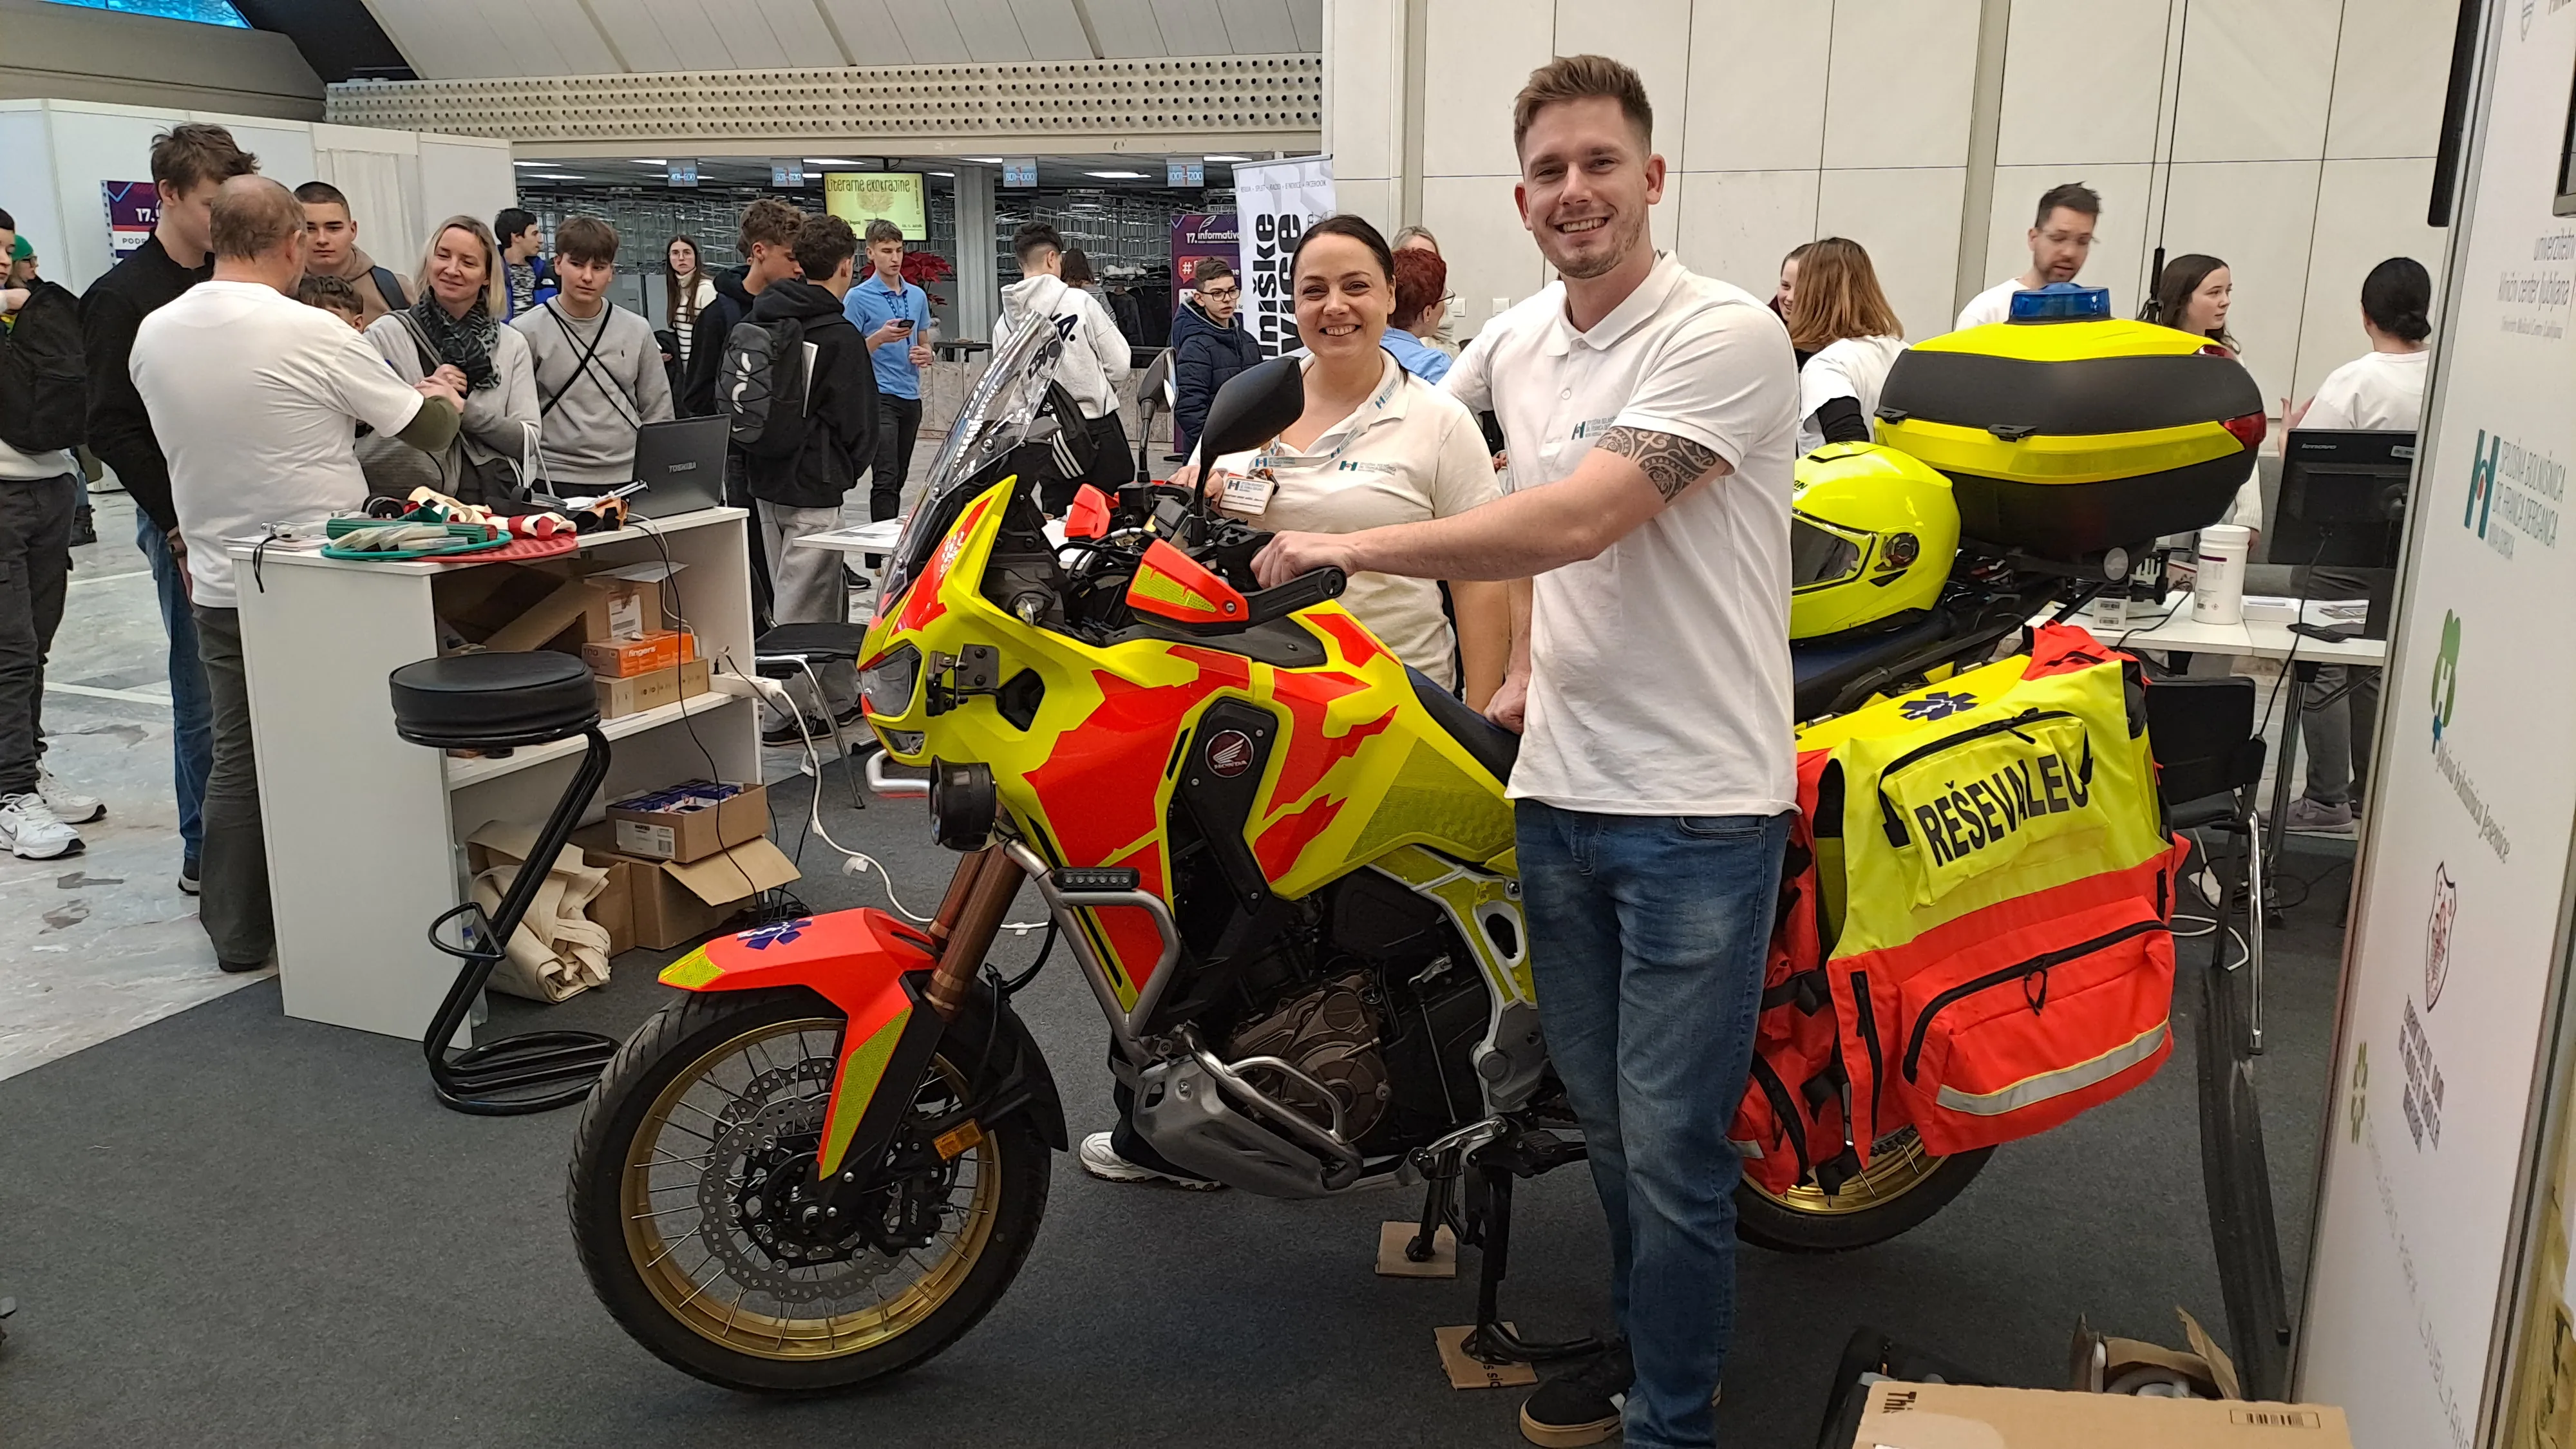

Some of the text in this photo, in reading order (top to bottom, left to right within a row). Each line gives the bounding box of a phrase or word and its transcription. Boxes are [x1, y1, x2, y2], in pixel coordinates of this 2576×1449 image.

[135, 208, 155, 222] 17.
[1186, 232, 1197, 244] 17.
[668, 461, 697, 473] TOSHIBA
[628, 645, 657, 658] fingers
